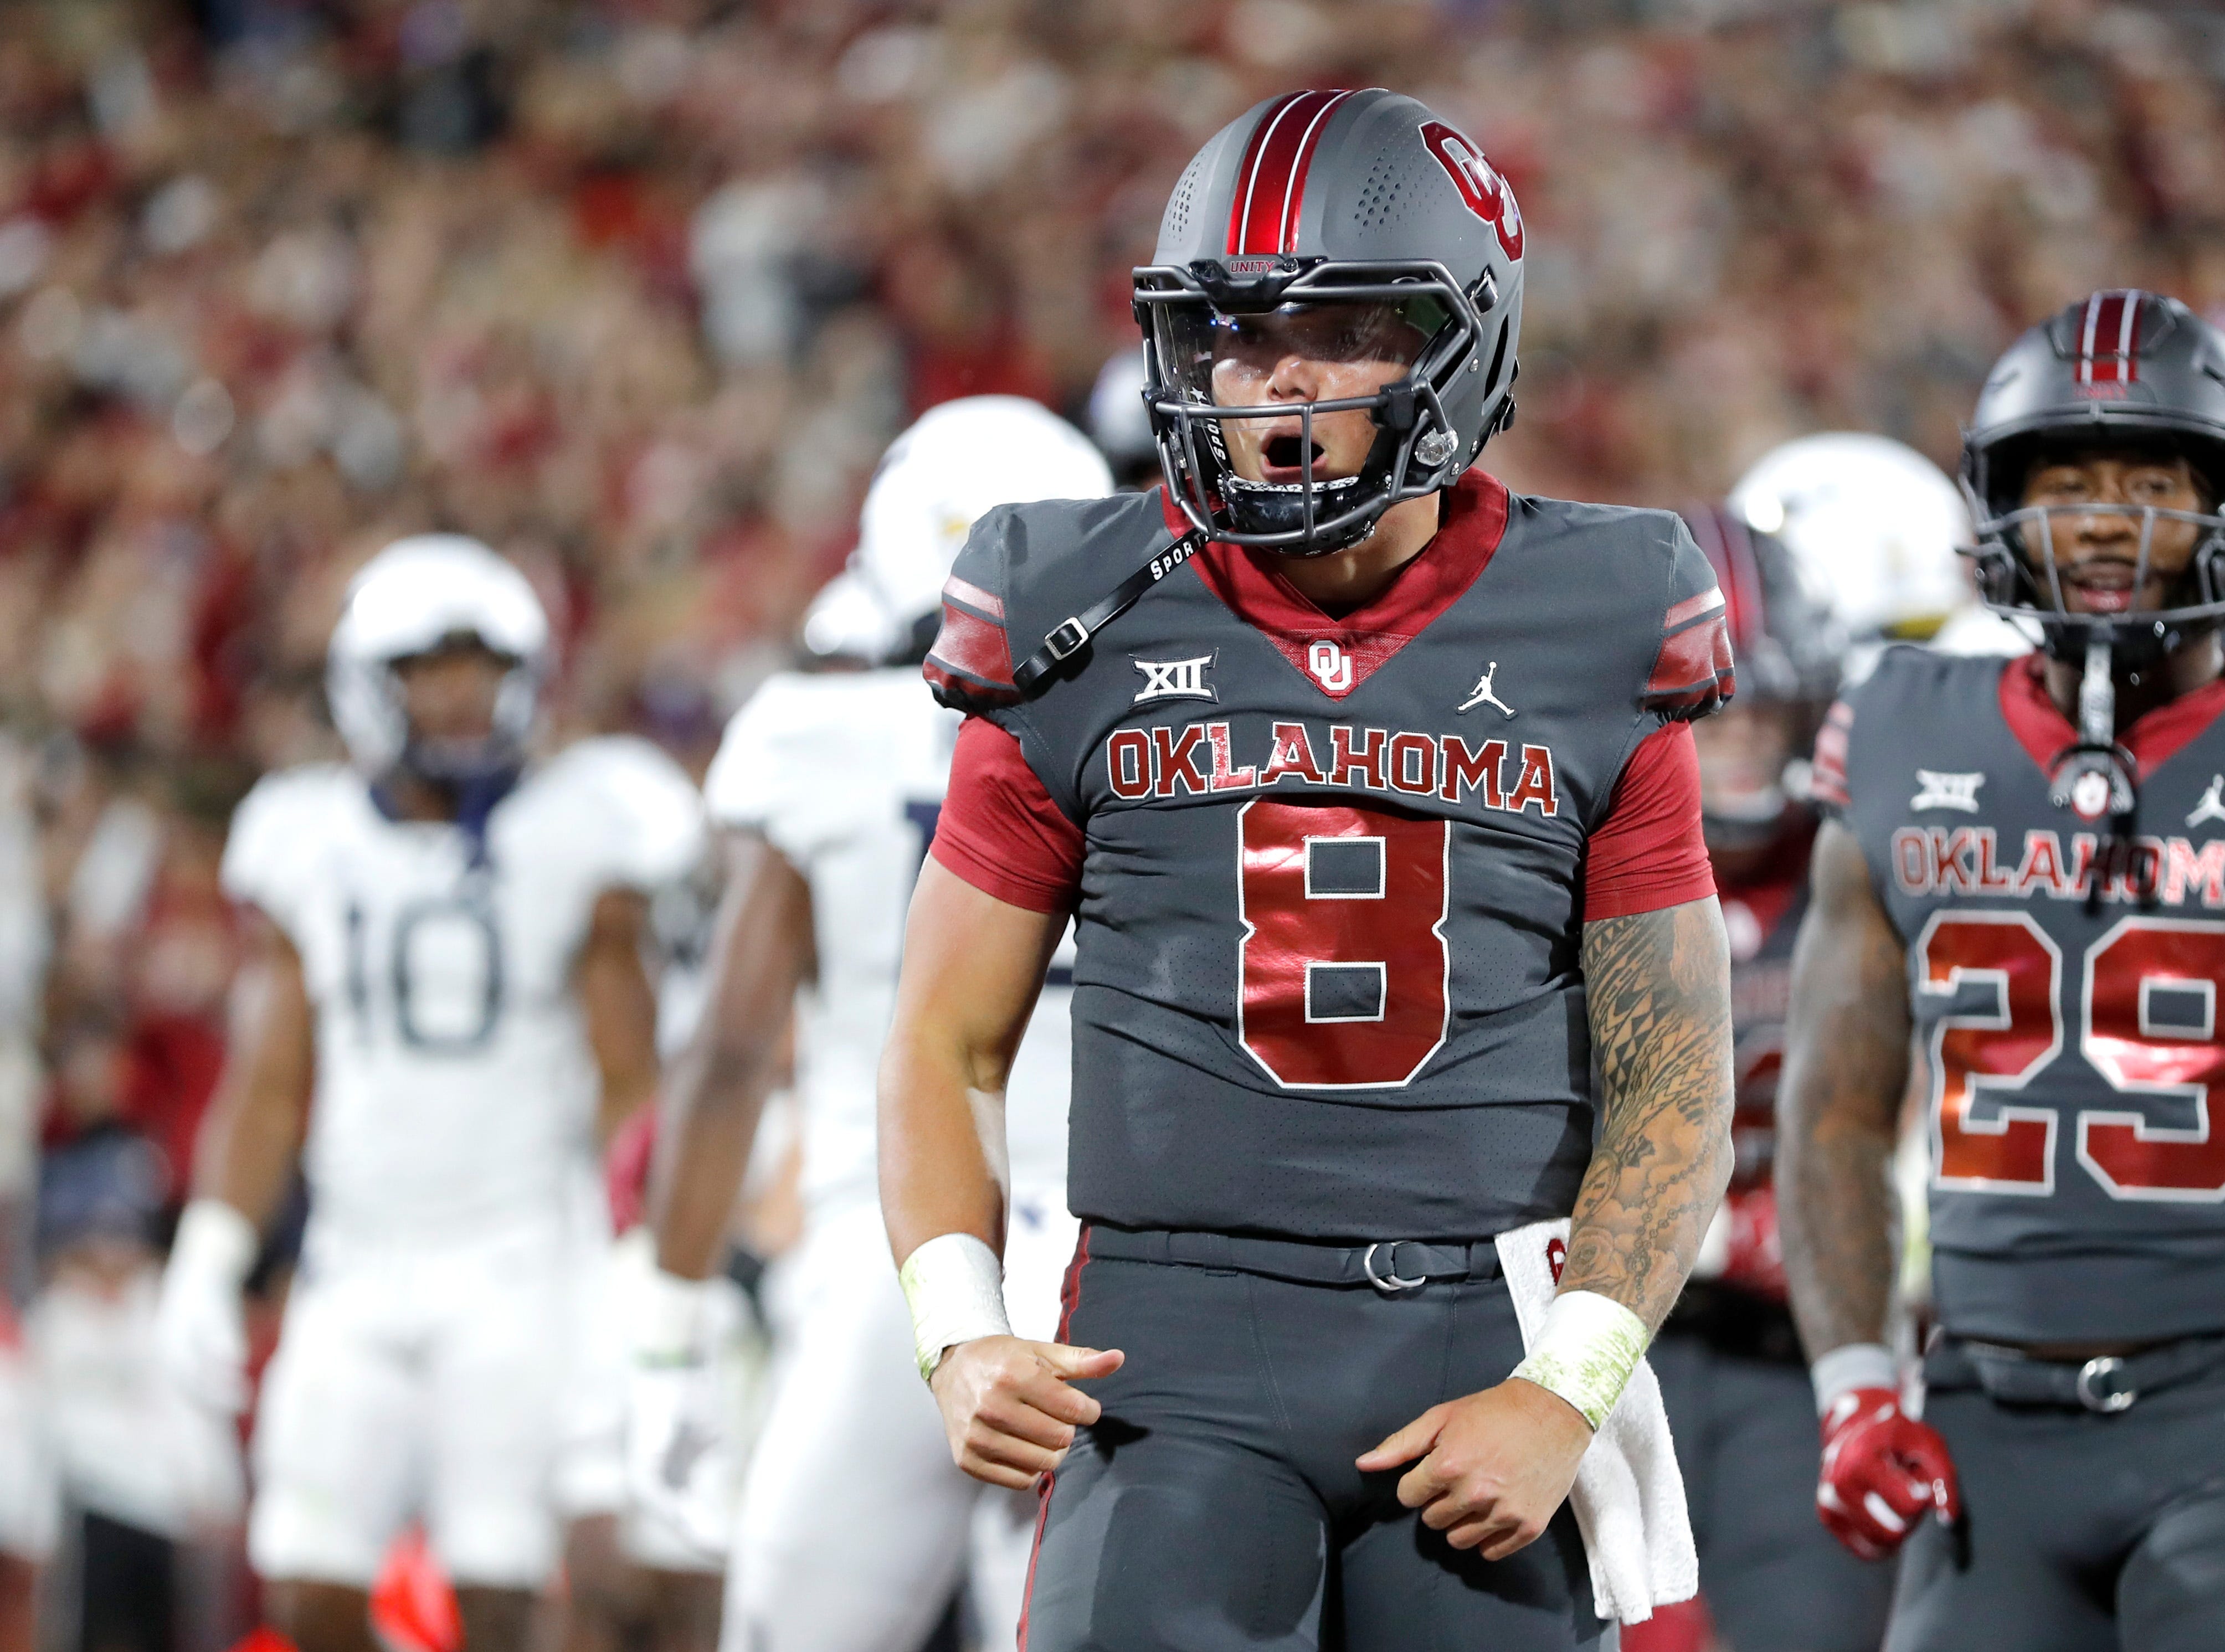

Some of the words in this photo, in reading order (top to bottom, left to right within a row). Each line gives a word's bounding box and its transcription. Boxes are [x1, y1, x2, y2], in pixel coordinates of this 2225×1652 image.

[1230, 260, 1276, 273] UNITY
[1133, 655, 1212, 702] XII
[1308, 640, 1352, 692] OU
[1107, 723, 1559, 816] OKLAHOMA
[1237, 794, 1451, 1089] 8
[1916, 909, 2225, 1203] 29
